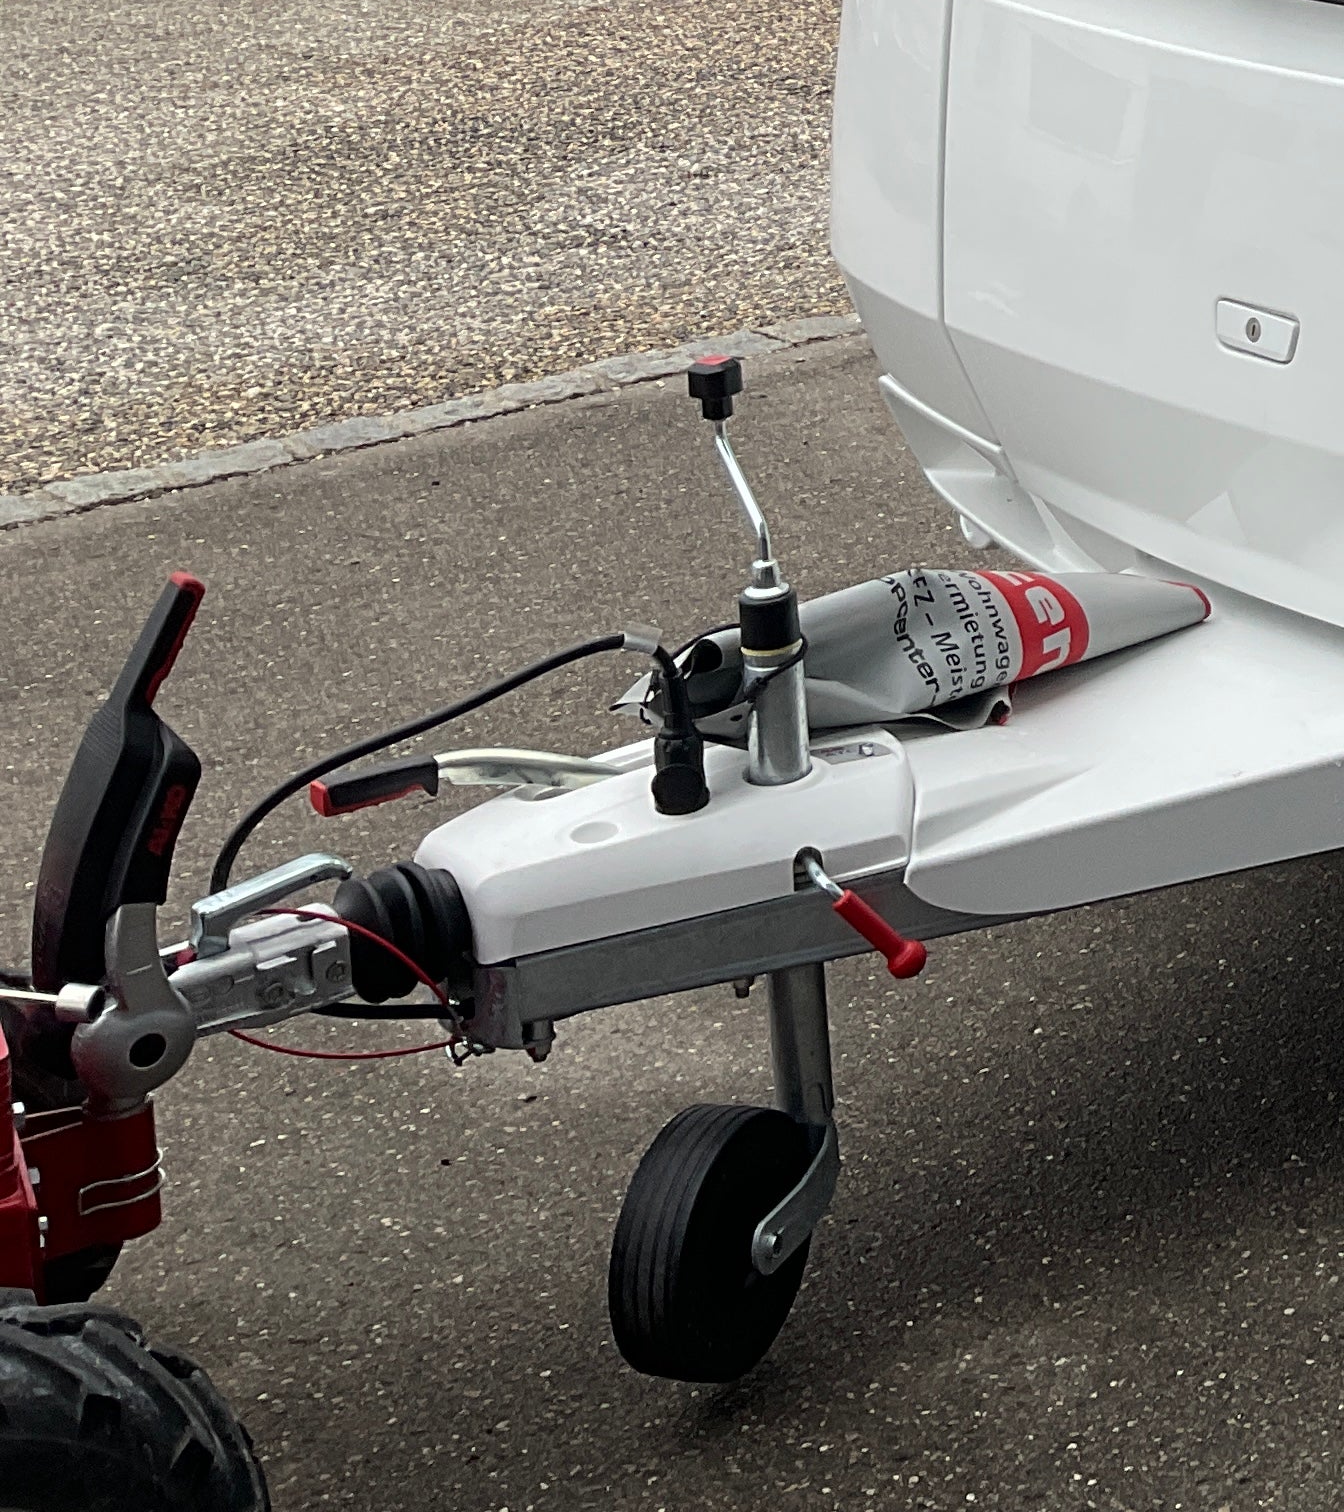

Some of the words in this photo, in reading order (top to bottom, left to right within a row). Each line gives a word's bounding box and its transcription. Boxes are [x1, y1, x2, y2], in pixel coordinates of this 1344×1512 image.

[930, 631, 967, 699] Meist
[938, 573, 988, 689] ermietung
[959, 573, 1010, 683] ohnwage
